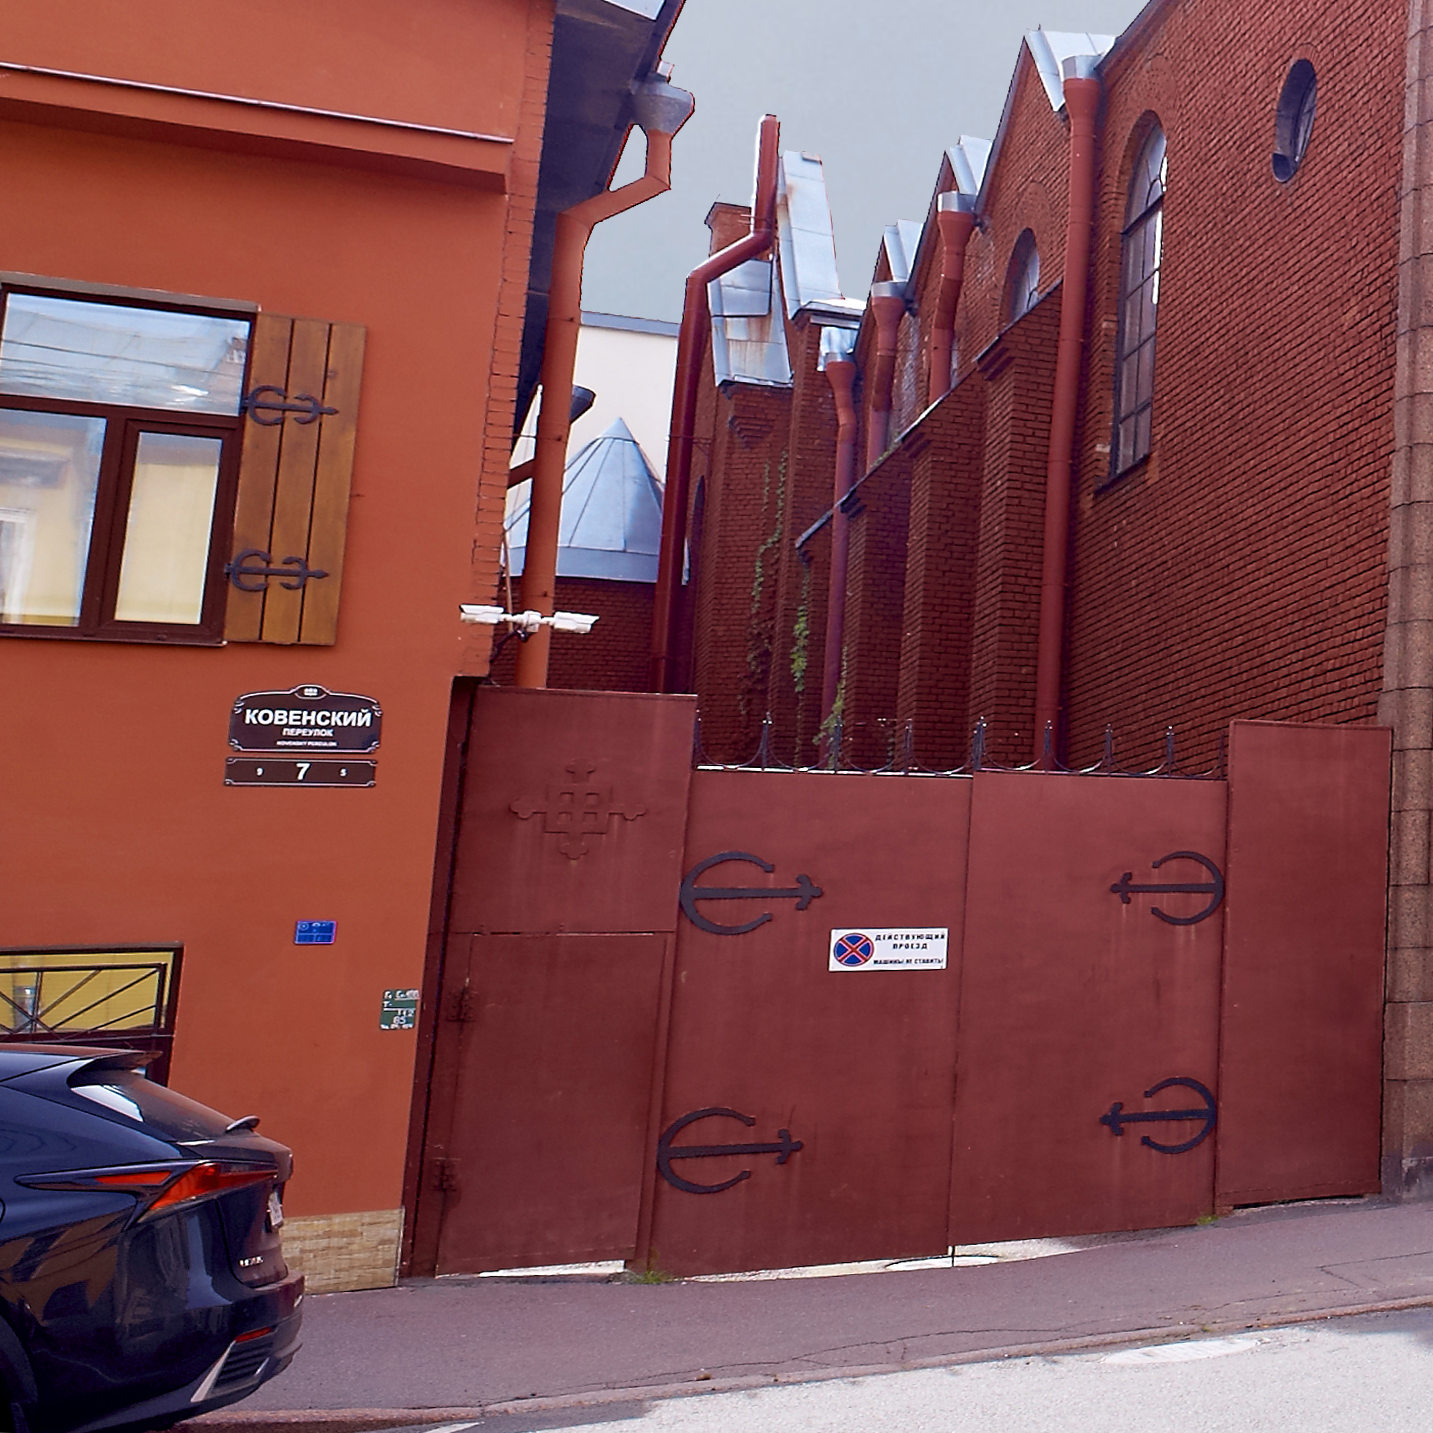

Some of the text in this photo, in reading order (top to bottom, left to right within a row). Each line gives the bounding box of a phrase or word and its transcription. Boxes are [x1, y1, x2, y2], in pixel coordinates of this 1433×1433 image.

[244, 708, 372, 727] КОВЕНСКИЙ
[282, 728, 334, 737] ПЕРЕУЛОК
[256, 767, 264, 776] 9
[295, 762, 311, 780] 7
